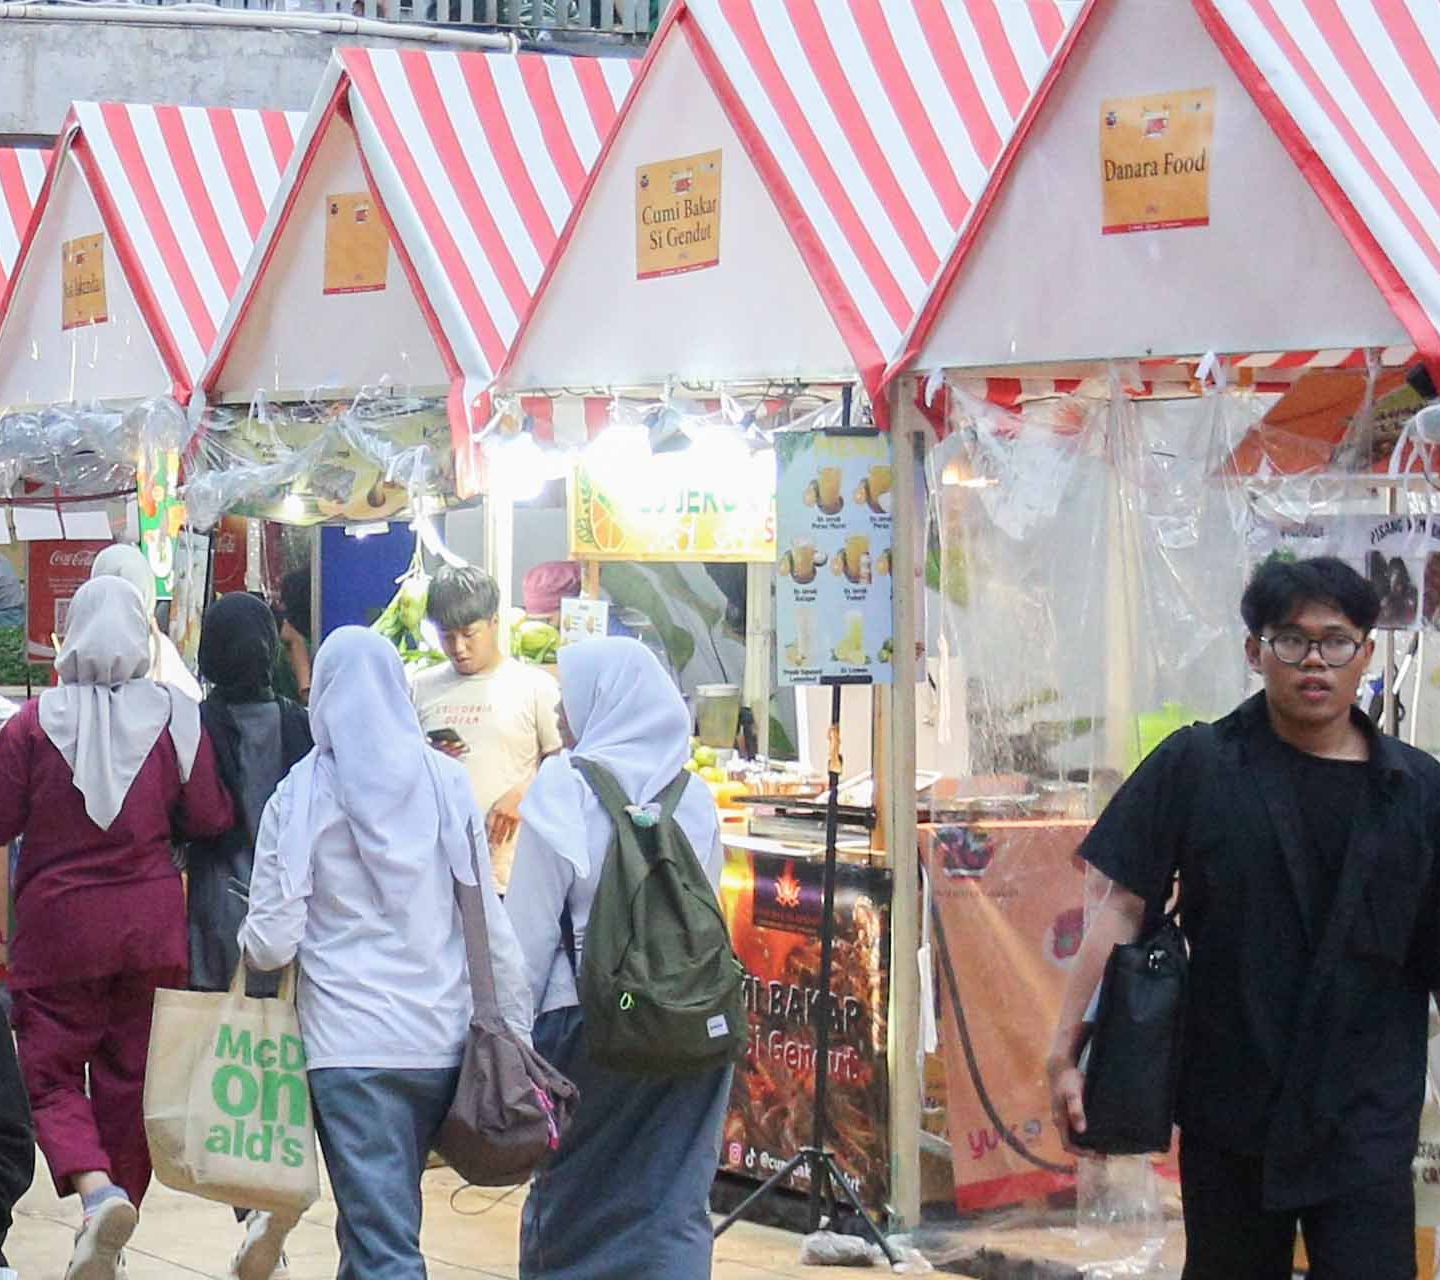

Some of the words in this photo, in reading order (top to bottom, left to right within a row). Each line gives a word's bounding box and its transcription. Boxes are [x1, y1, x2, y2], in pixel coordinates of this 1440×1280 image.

[1104, 159, 1158, 181] Danara
[1164, 146, 1206, 175] Food
[641, 201, 681, 224] Cumi
[684, 195, 717, 218] Bakar
[649, 228, 663, 250] Si
[666, 221, 712, 247] Gendut
[214, 1023, 307, 1070] McD
[211, 1064, 308, 1127] on
[204, 1119, 305, 1169] ald's
